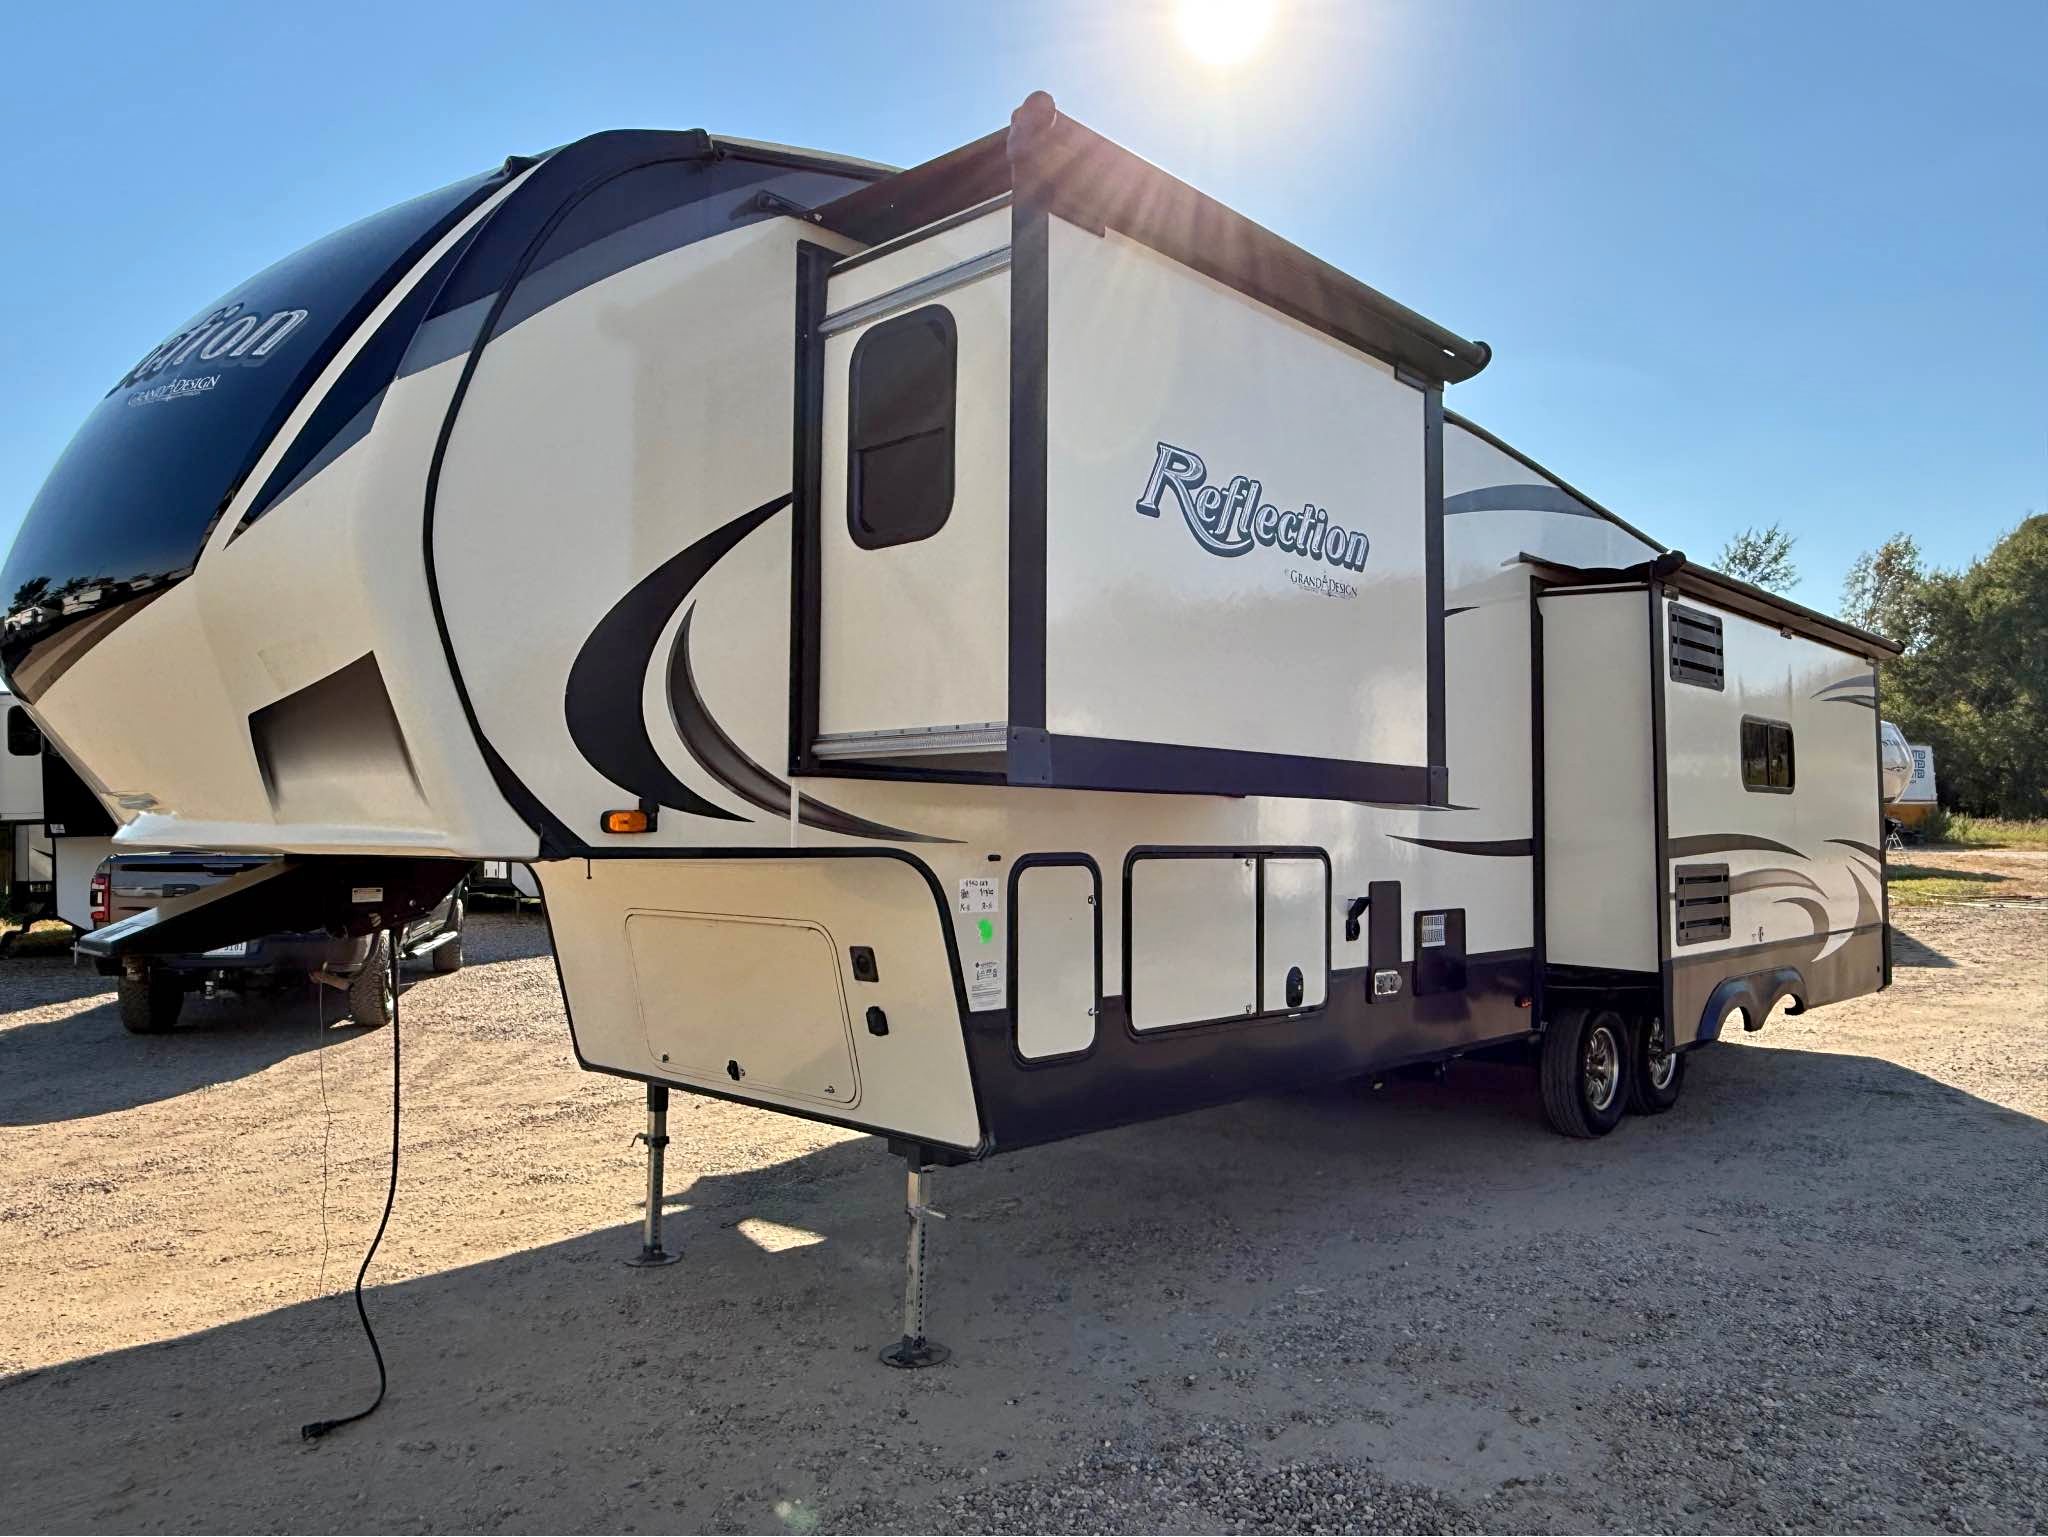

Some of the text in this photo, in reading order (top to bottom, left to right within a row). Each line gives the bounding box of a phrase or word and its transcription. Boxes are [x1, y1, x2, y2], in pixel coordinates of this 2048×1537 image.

[173, 374, 221, 393] DESIGN
[1135, 441, 1370, 573] Reflection
[1289, 569, 1322, 589] GRAND
[1327, 579, 1358, 597] DESIGN
